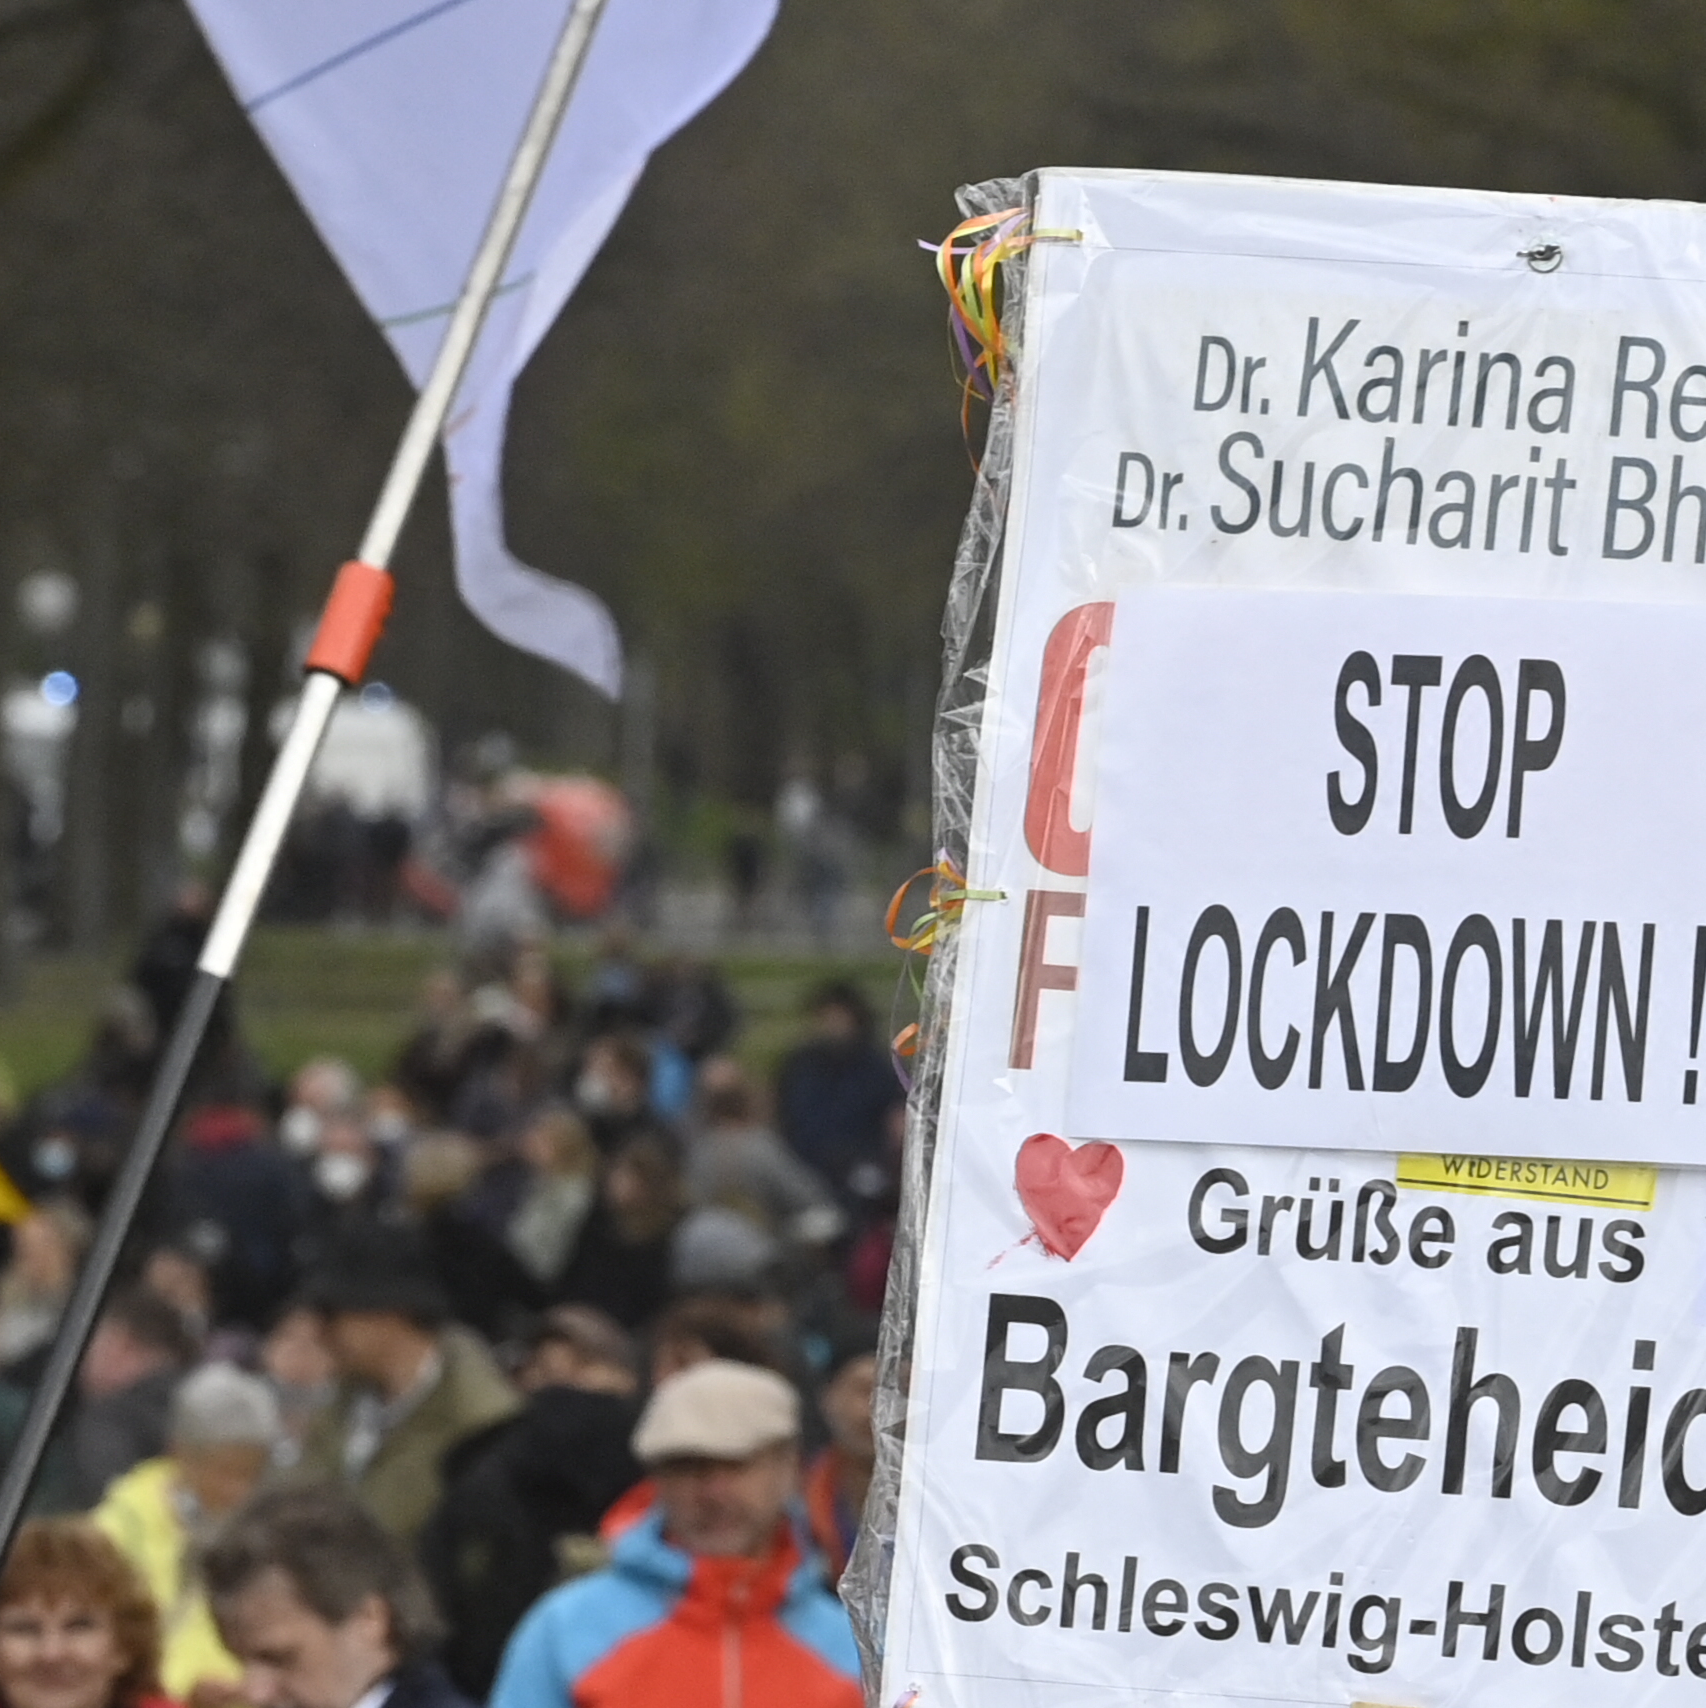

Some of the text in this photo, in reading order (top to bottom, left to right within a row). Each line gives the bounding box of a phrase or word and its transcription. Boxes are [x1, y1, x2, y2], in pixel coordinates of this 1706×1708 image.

[1192, 334, 1271, 416] Dr.
[1295, 316, 1577, 434] Karina
[1110, 450, 1189, 532] Dr.
[1209, 431, 1577, 557] Sucharit
[1325, 649, 1567, 840] STOP
[1122, 903, 1657, 1102] LOCKDOWN
[1187, 1166, 1647, 1284] Grüße aus
